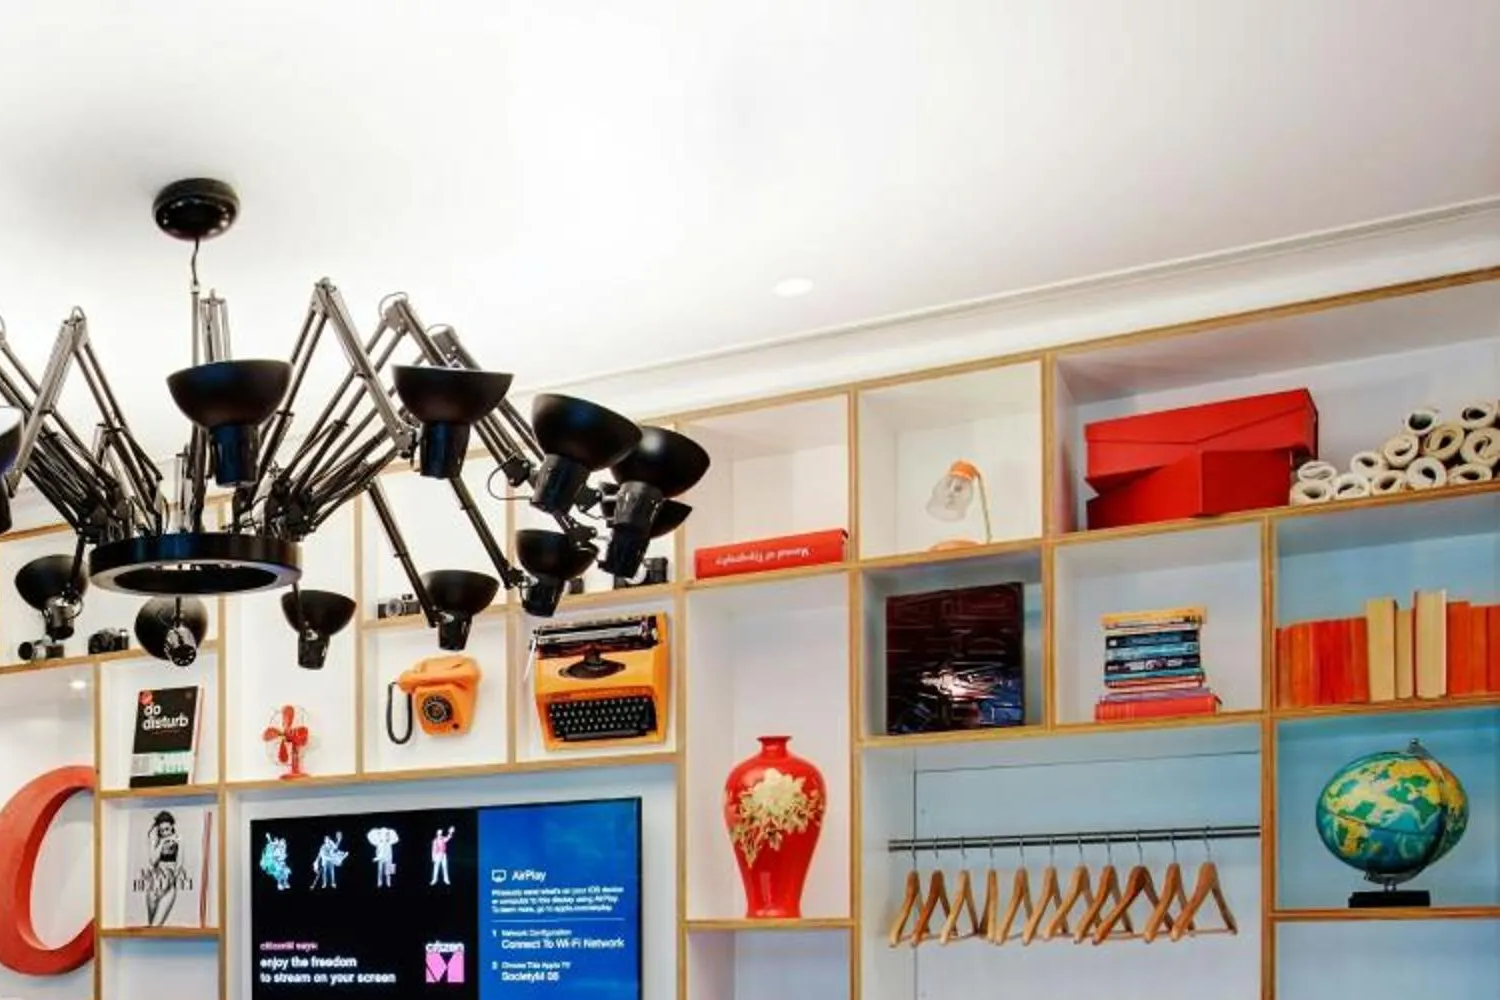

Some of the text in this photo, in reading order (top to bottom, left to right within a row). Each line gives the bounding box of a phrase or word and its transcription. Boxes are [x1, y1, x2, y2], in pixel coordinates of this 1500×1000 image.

[143, 702, 162, 717] do
[142, 713, 190, 731] disturb
[511, 869, 547, 882] AirPlay
[501, 938, 541, 949] Connect
[543, 939, 555, 949] To
[583, 937, 625, 949] Network
[259, 955, 358, 970] enjoy the freedom
[259, 973, 397, 987] to stream on your screen
